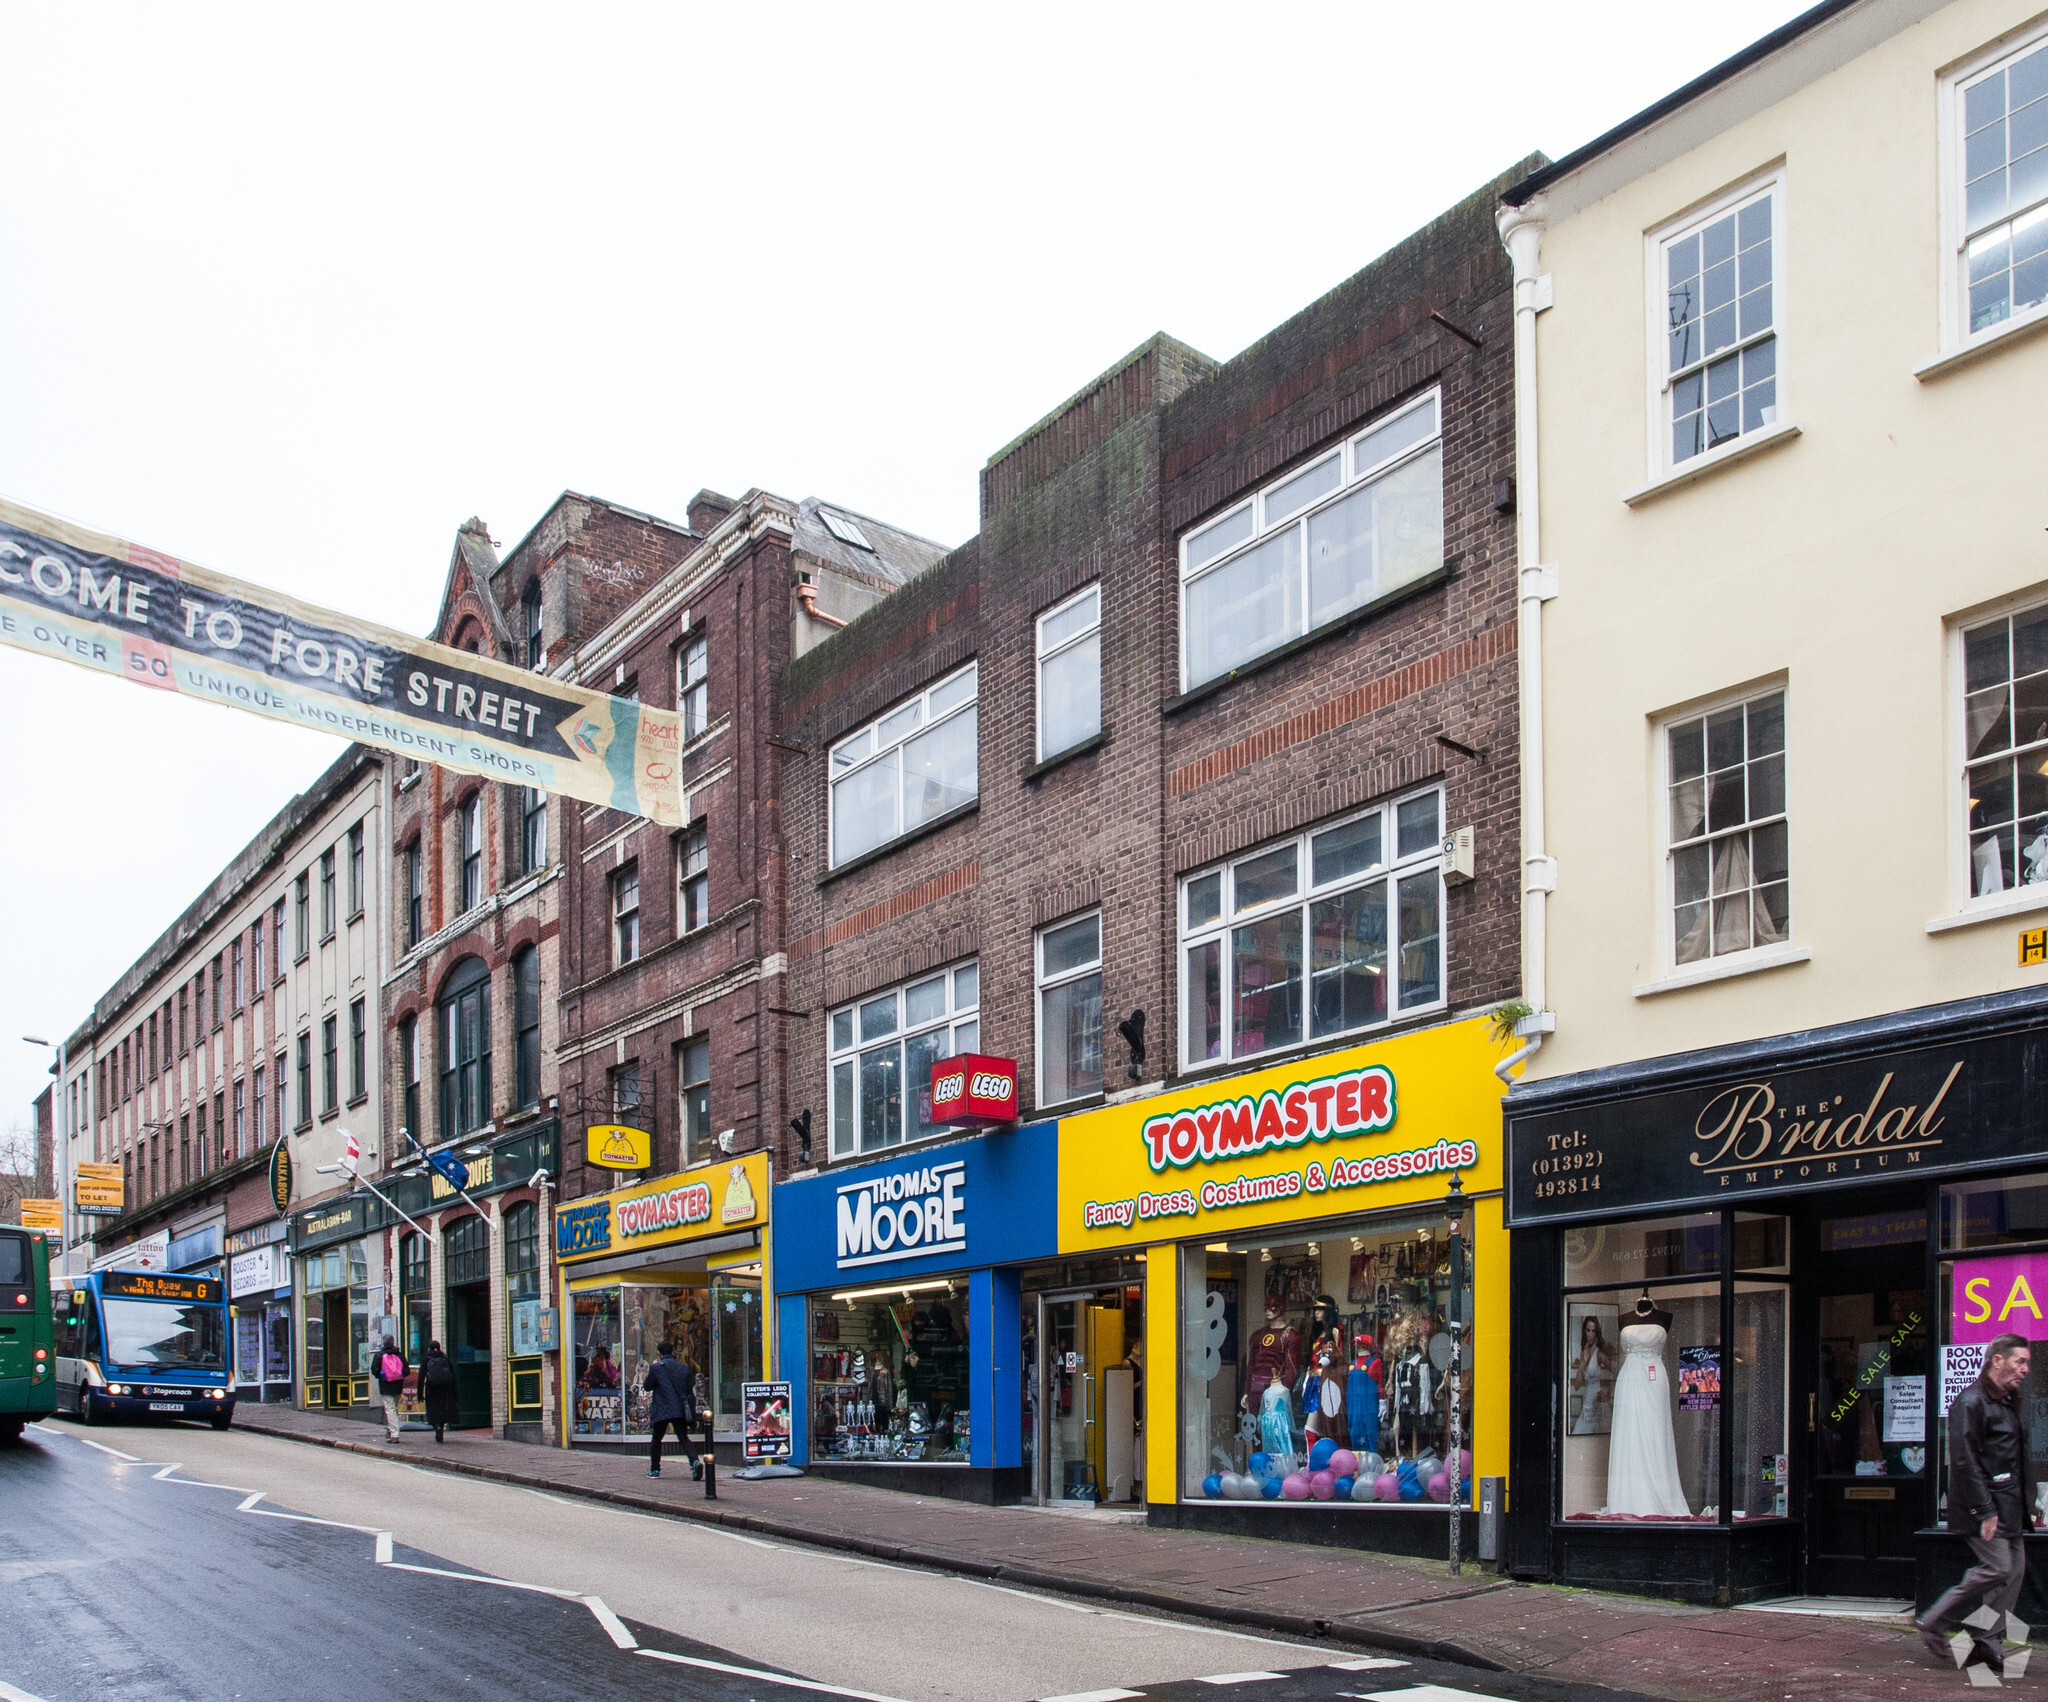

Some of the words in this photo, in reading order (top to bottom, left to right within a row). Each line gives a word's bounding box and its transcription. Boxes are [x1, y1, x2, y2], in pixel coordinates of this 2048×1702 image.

[180, 598, 243, 650] TO
[270, 628, 385, 695] FORE
[407, 671, 541, 738] STREET
[33, 626, 108, 662] OVER
[129, 651, 168, 678] 50
[188, 671, 285, 709] UNIQUE
[298, 702, 457, 756] INDEPENDENT
[470, 747, 536, 777] SHOPS
[642, 717, 679, 740] heart
[2032, 934, 2038, 943] 6
[2030, 949, 2039, 958] 14
[934, 1073, 964, 1103] LEGO
[971, 1072, 1012, 1101] LEGO
[1146, 1072, 1391, 1166] TOYMASTER
[1689, 1060, 1965, 1167] Bridal
[1777, 1101, 1829, 1120] THE
[1547, 1130, 1588, 1152] Tel:
[603, 1152, 635, 1162] TOYMASTER
[1532, 1150, 1603, 1177] (01392)
[277, 1151, 287, 1206] WALKABOUT
[1720, 1151, 1921, 1187] EMPORIUM
[872, 1166, 942, 1204] THOMAS
[1085, 1200, 1134, 1227] Fancy
[1140, 1191, 1196, 1218] Dress,
[1202, 1176, 1299, 1205] Costumes
[1306, 1164, 1325, 1190] &
[1331, 1141, 1475, 1186] Accessories
[1534, 1174, 1602, 1199] 493814
[571, 1202, 600, 1222] THOMAS
[617, 1186, 709, 1235] TOYMASTER
[724, 1204, 752, 1218] TOYMASTER
[837, 1171, 965, 1257] MOORE
[557, 1206, 610, 1250] MOORE
[138, 1243, 164, 1252] tattoo
[233, 1257, 257, 1275] ROOSTER
[136, 1277, 154, 1289] The
[158, 1279, 181, 1291] Quay
[197, 1283, 207, 1299] G
[233, 1274, 257, 1291] RECORDS
[1946, 1346, 1984, 1359] BOOK
[1946, 1357, 1983, 1371] NOW
[1831, 1387, 1862, 1422] SALE
[1860, 1350, 1892, 1385] SALE
[1891, 1311, 1922, 1347] SALE
[152, 1387, 193, 1396] Stagecoach
[1485, 1503, 1491, 1512] 7
